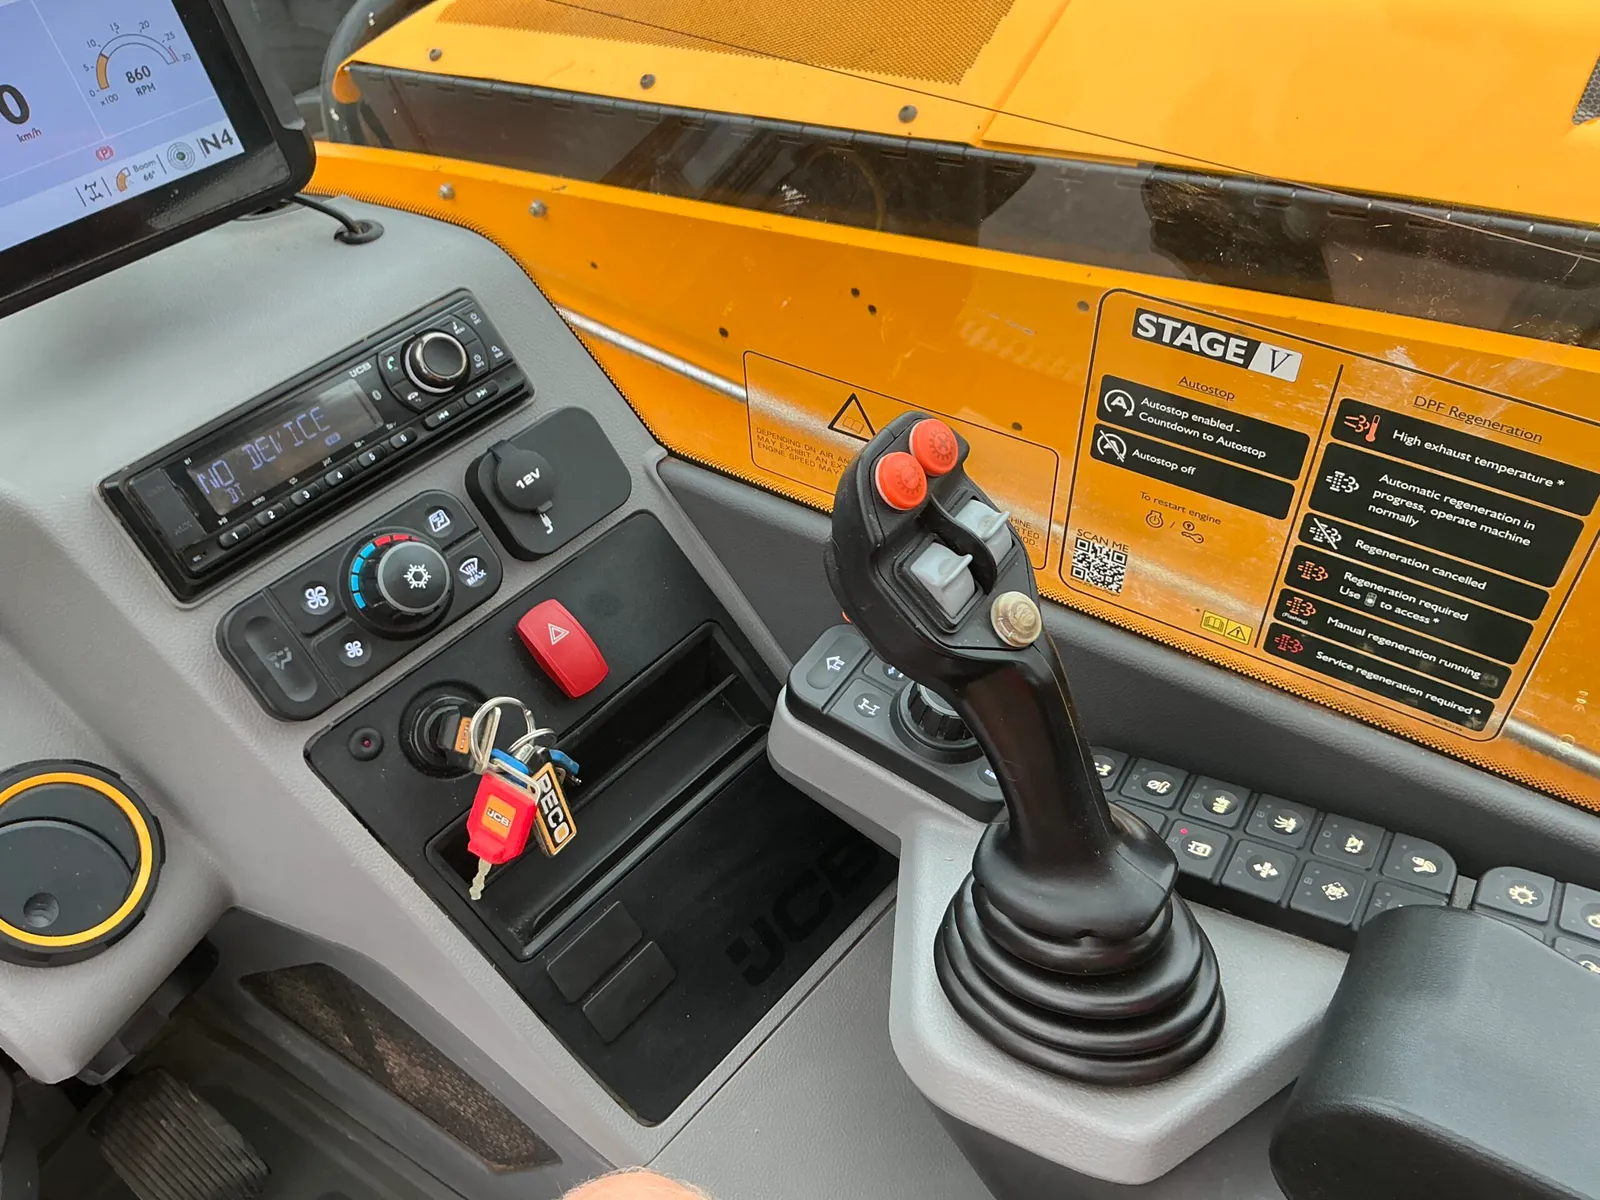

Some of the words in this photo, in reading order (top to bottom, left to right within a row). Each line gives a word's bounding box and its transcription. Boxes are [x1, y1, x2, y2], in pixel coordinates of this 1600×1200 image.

[109, 22, 120, 31] 15
[138, 20, 150, 30] 20
[164, 31, 176, 41] 25
[86, 39, 97, 48] 10
[83, 64, 90, 72] 5
[125, 65, 151, 84] 860
[89, 89, 96, 97] 0
[100, 93, 119, 106] x100
[135, 82, 156, 96] RPM
[17, 127, 42, 143] km/h
[201, 128, 234, 155] N4
[132, 160, 157, 173] Boom
[1136, 313, 1248, 365] STAGE
[1270, 349, 1295, 374] V
[1178, 376, 1236, 402] Autostop
[1141, 397, 1190, 420] Autostop
[1191, 412, 1234, 433] enabled
[1413, 395, 1446, 412] DPF
[1448, 405, 1544, 444] Regeneration
[400, 434, 407, 442] 6
[756, 427, 801, 448] DEPENDING
[804, 444, 816, 453] ON
[820, 450, 834, 459] AIR
[1138, 412, 1200, 438] Countdown
[1202, 432, 1214, 443] to
[1216, 435, 1267, 460] Autostop
[197, 459, 235, 494] NO
[242, 407, 331, 470] DEVICE
[369, 452, 376, 461] 5
[756, 434, 776, 446] MAY
[779, 443, 811, 458] EXHIBIT
[815, 455, 828, 465] AN
[757, 442, 785, 457] ENGINE
[788, 453, 816, 468] SPEED
[818, 463, 840, 475] MAY
[1131, 449, 1179, 471] Autostop
[1180, 465, 1197, 476] off
[1392, 429, 1421, 449] High
[1424, 440, 1472, 462] exhaust
[1474, 454, 1554, 488] temperature
[337, 471, 344, 480] 4
[515, 467, 541, 489] 12V
[302, 490, 310, 499] 3
[1379, 474, 1441, 501] Automatic
[1443, 493, 1521, 527] regeneration
[1523, 519, 1537, 532] in
[267, 510, 275, 519] 2
[1140, 491, 1151, 502] To
[1153, 497, 1186, 514] restart
[1188, 509, 1222, 526] engine
[1368, 504, 1420, 528] normally
[1372, 489, 1427, 514] progress,
[1430, 507, 1478, 530] operate
[1479, 522, 1531, 547] machine
[1077, 528, 1109, 546] SCAN
[1112, 541, 1130, 553] ME
[466, 569, 487, 585] MAX
[1355, 539, 1430, 572] Regeneration
[1432, 567, 1487, 591] cancelled
[1339, 585, 1361, 600] Use
[1380, 601, 1393, 612] to
[1394, 606, 1430, 624] access
[1344, 571, 1417, 603] Regeneration
[1418, 598, 1470, 622] required
[1327, 616, 1366, 637] Manual
[1367, 632, 1437, 663] regeneration
[1438, 659, 1482, 681] running
[1315, 651, 1354, 671] Service
[1355, 665, 1423, 697] regeneration
[1425, 691, 1473, 716] required
[486, 807, 510, 828] JCB
[538, 772, 570, 844] PECO
[725, 842, 880, 986] JCB
